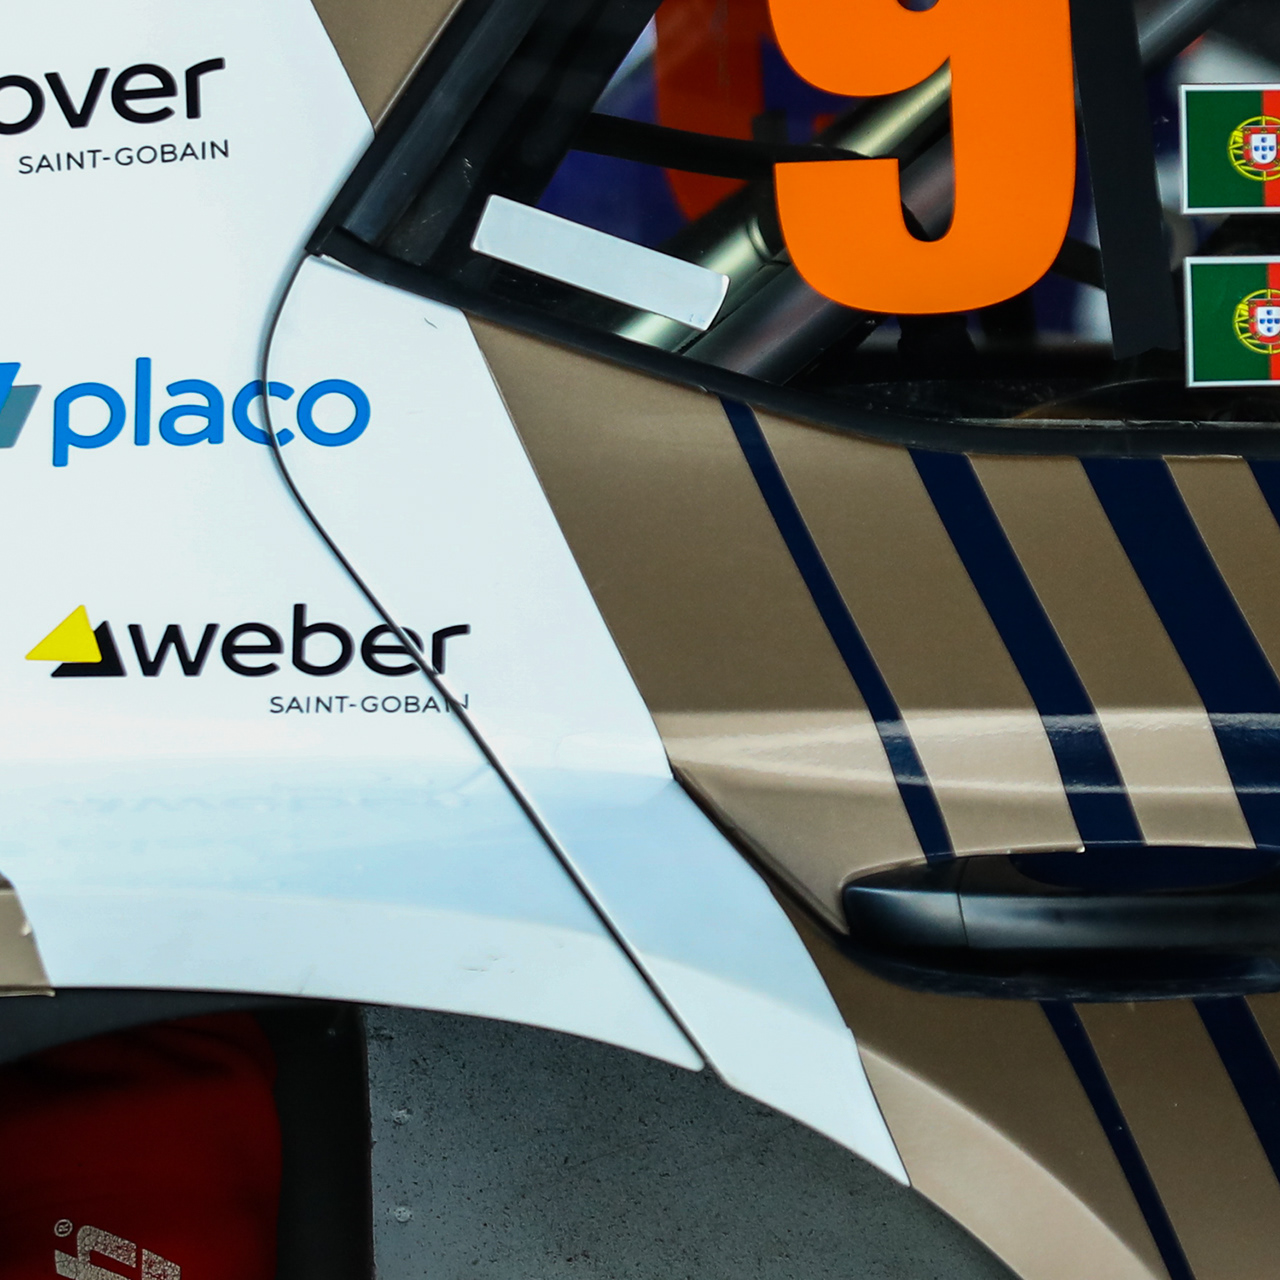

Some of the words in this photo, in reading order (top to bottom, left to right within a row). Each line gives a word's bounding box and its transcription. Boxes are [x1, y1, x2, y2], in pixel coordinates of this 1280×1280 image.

[18, 138, 229, 175] SAINT-GOBAIN
[51, 356, 371, 468] placo
[128, 603, 471, 678] weber
